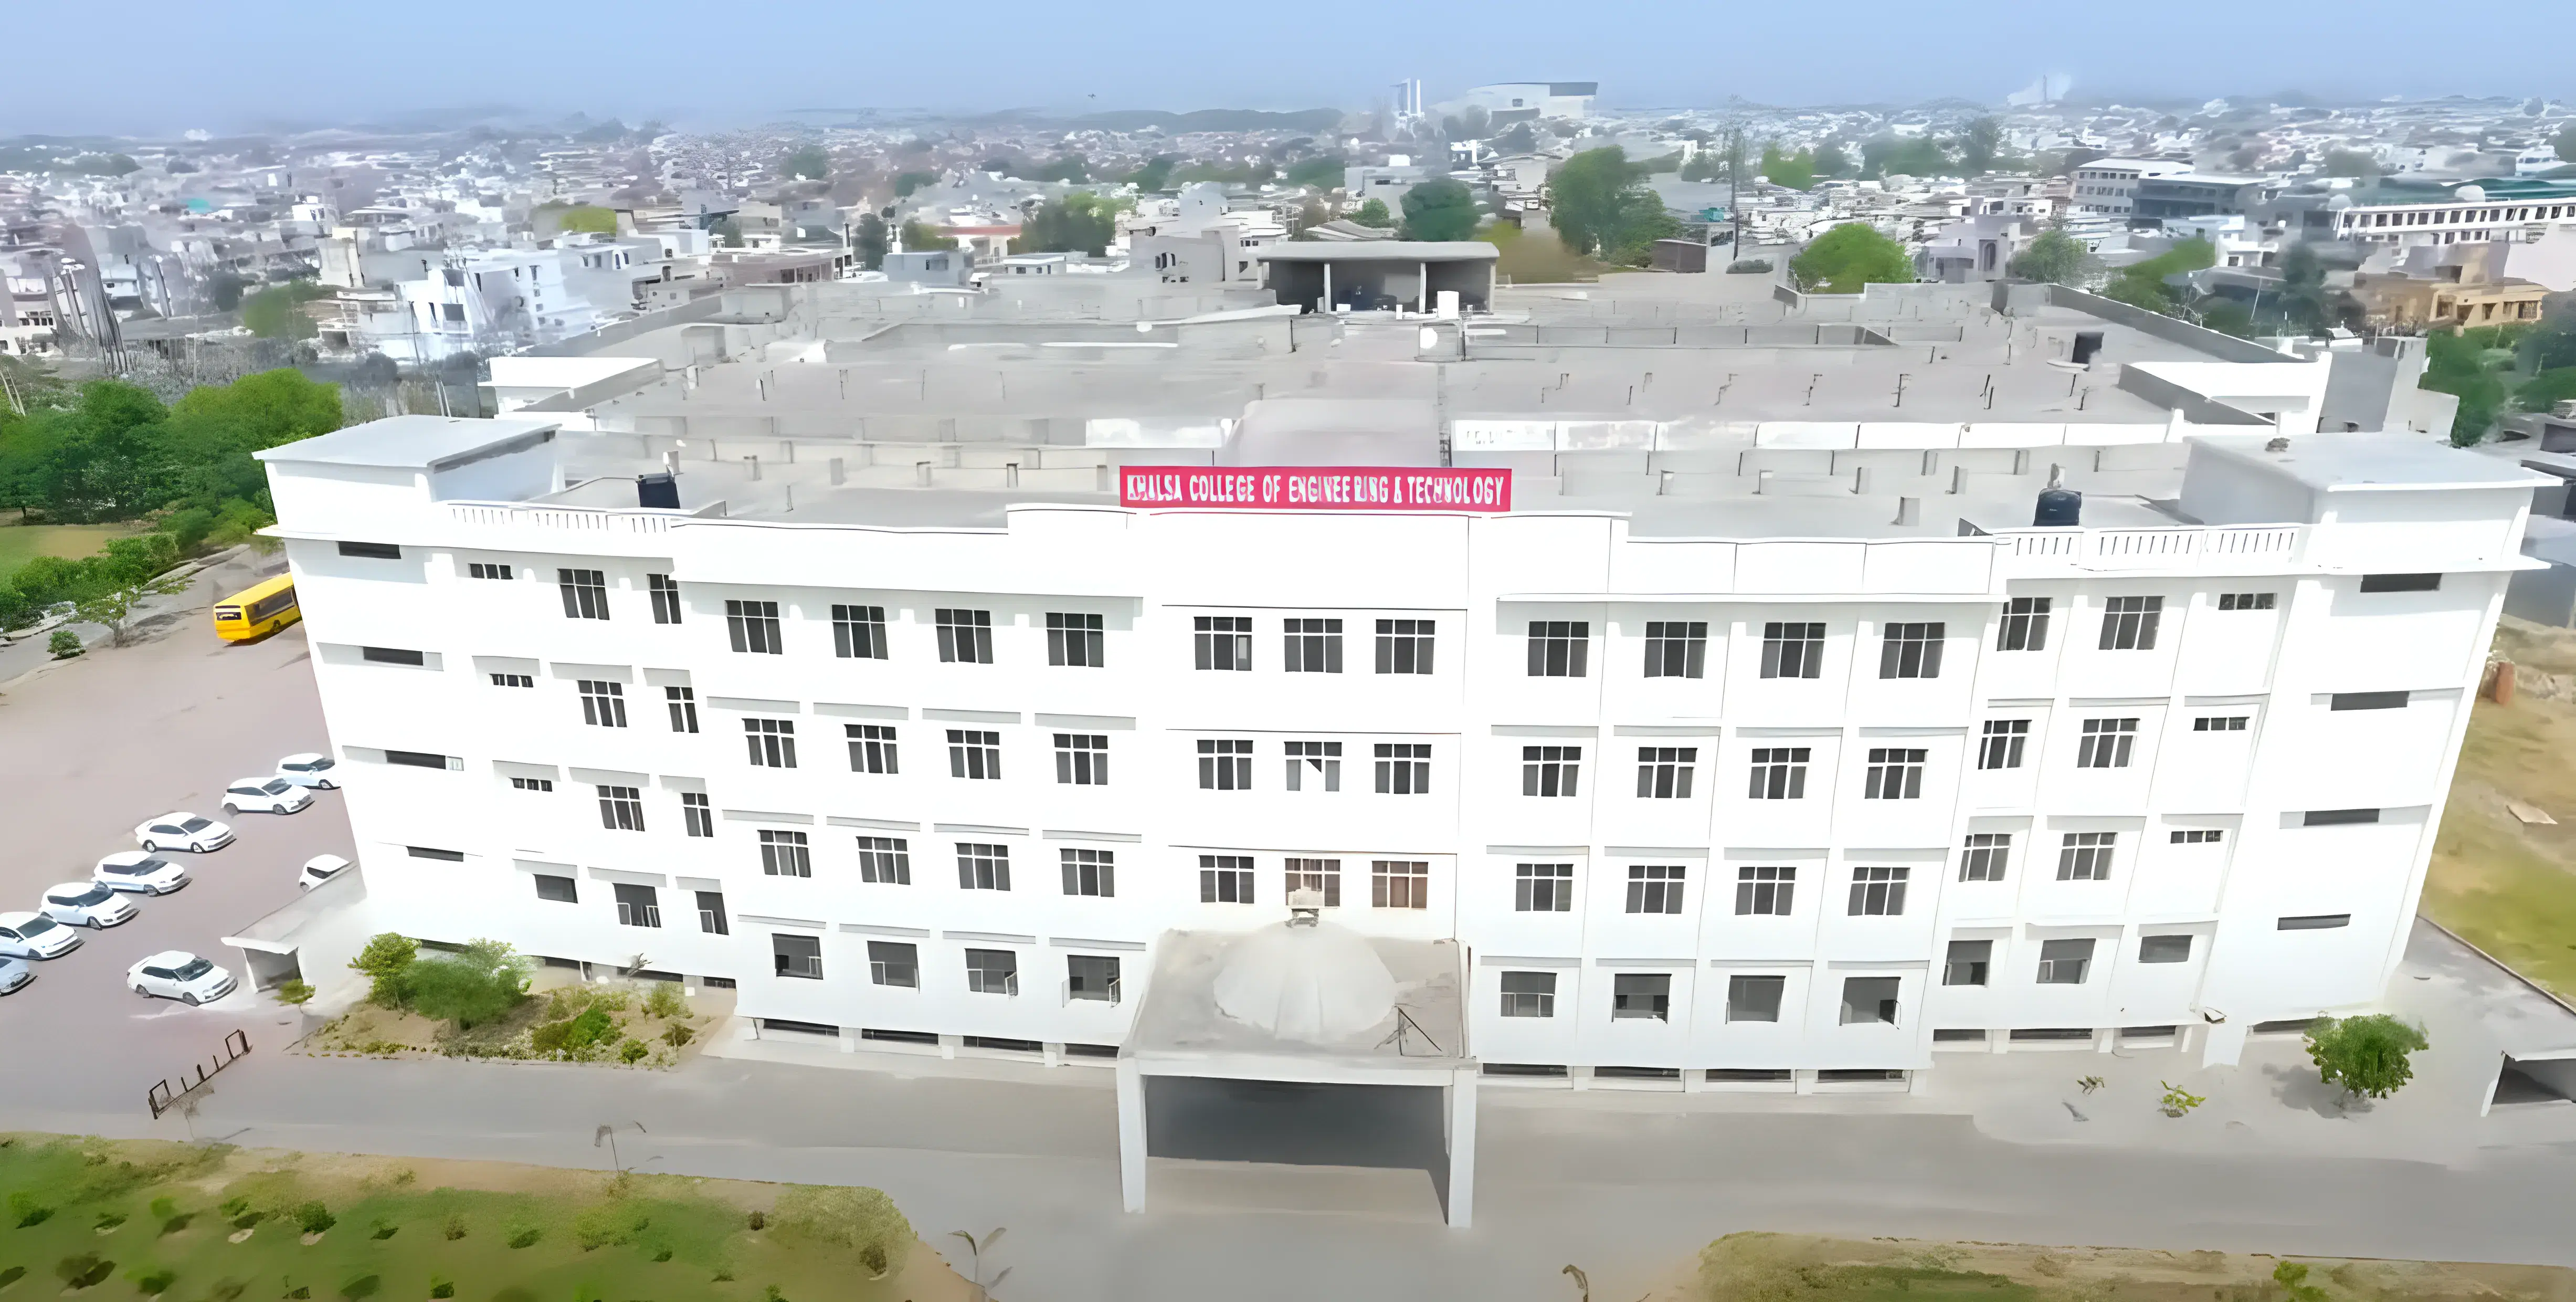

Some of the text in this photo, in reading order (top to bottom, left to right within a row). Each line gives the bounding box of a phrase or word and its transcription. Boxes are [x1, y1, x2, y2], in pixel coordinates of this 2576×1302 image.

[1189, 474, 1255, 502] COLLEGE
[1262, 475, 1281, 503] OF
[1407, 476, 1505, 505] TECHNOLOGY
